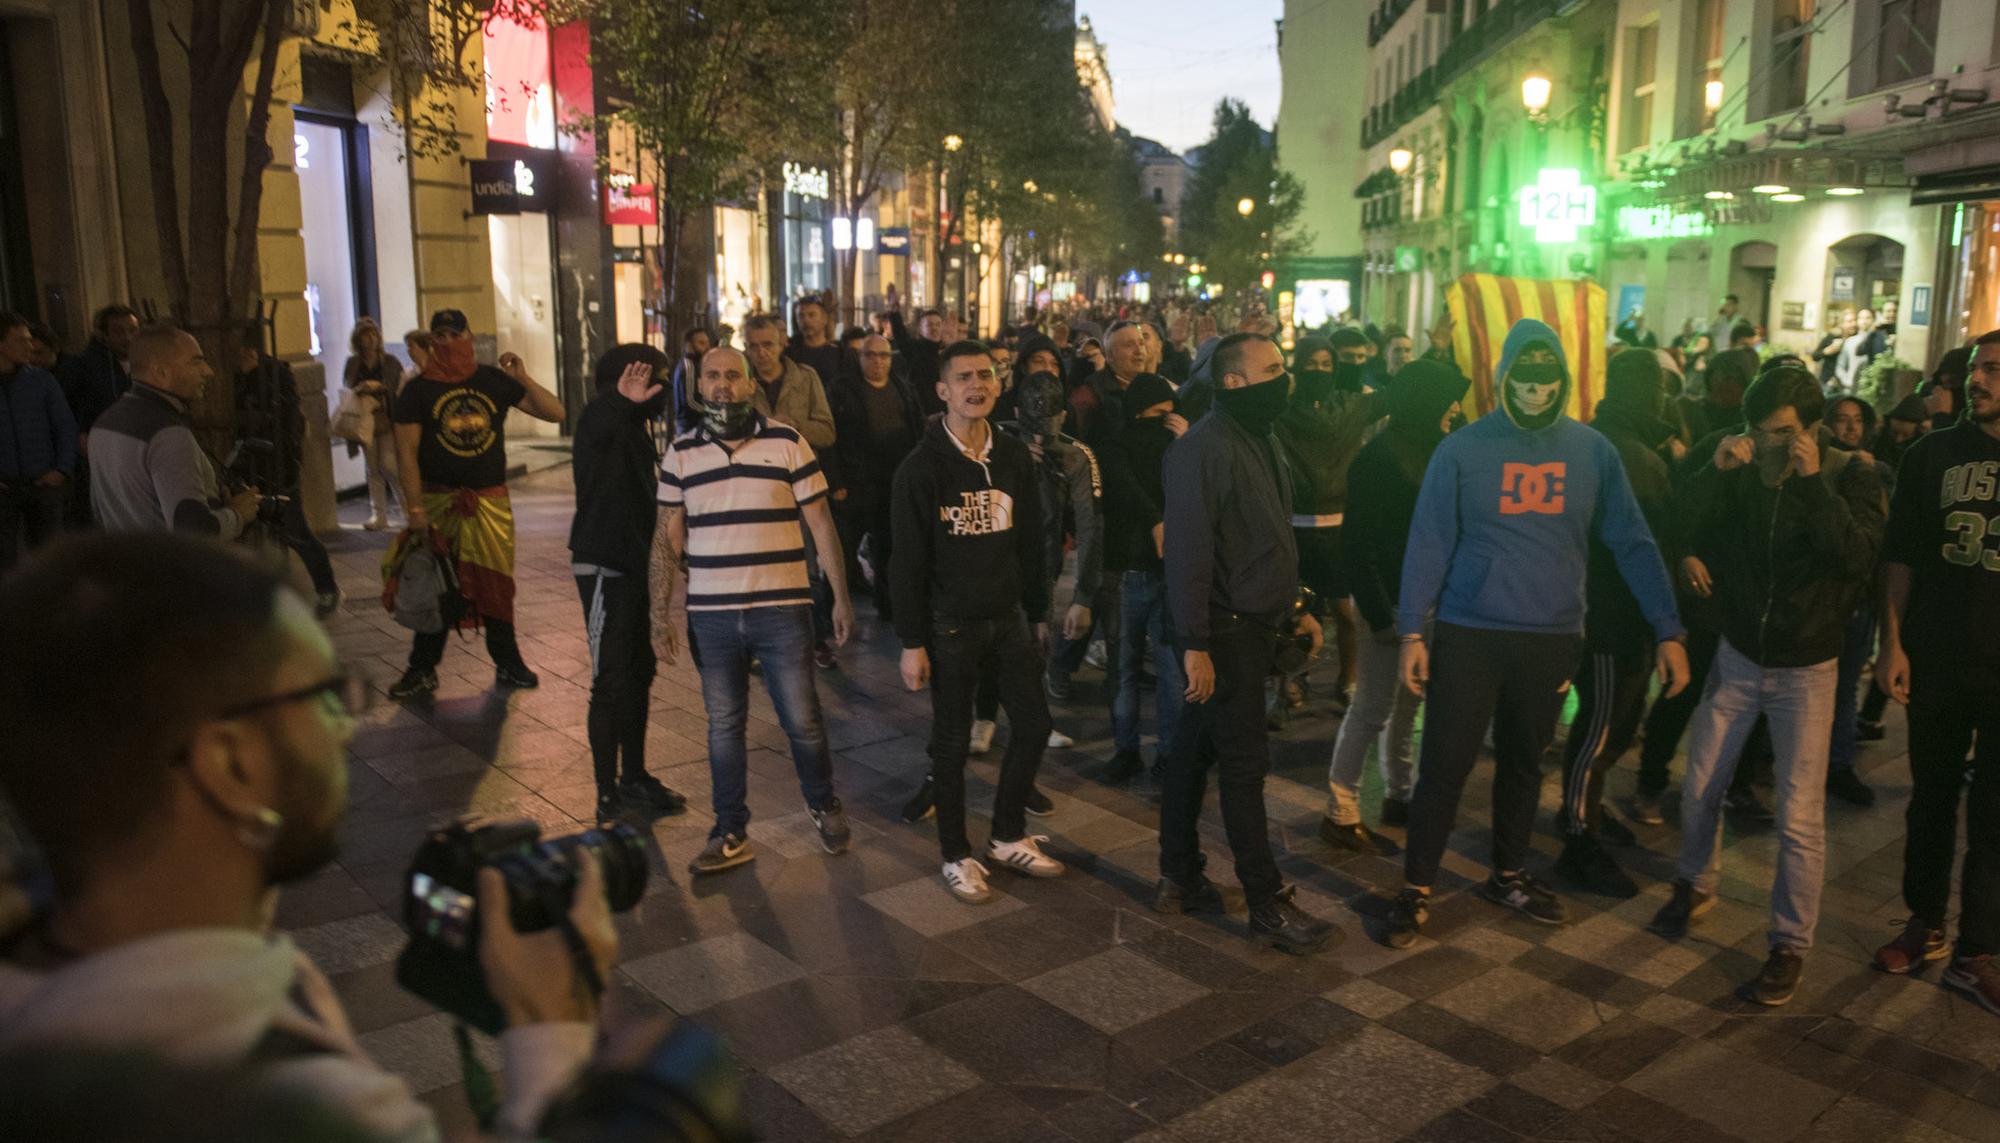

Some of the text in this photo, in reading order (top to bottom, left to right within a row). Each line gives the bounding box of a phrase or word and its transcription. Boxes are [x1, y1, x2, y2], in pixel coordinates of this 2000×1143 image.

[475, 181, 513, 196] undiz
[1527, 191, 1588, 220] 12H
[1941, 461, 2000, 509] BOS
[960, 490, 990, 507] THE
[939, 506, 991, 522] NORTH
[953, 520, 992, 535] FACE
